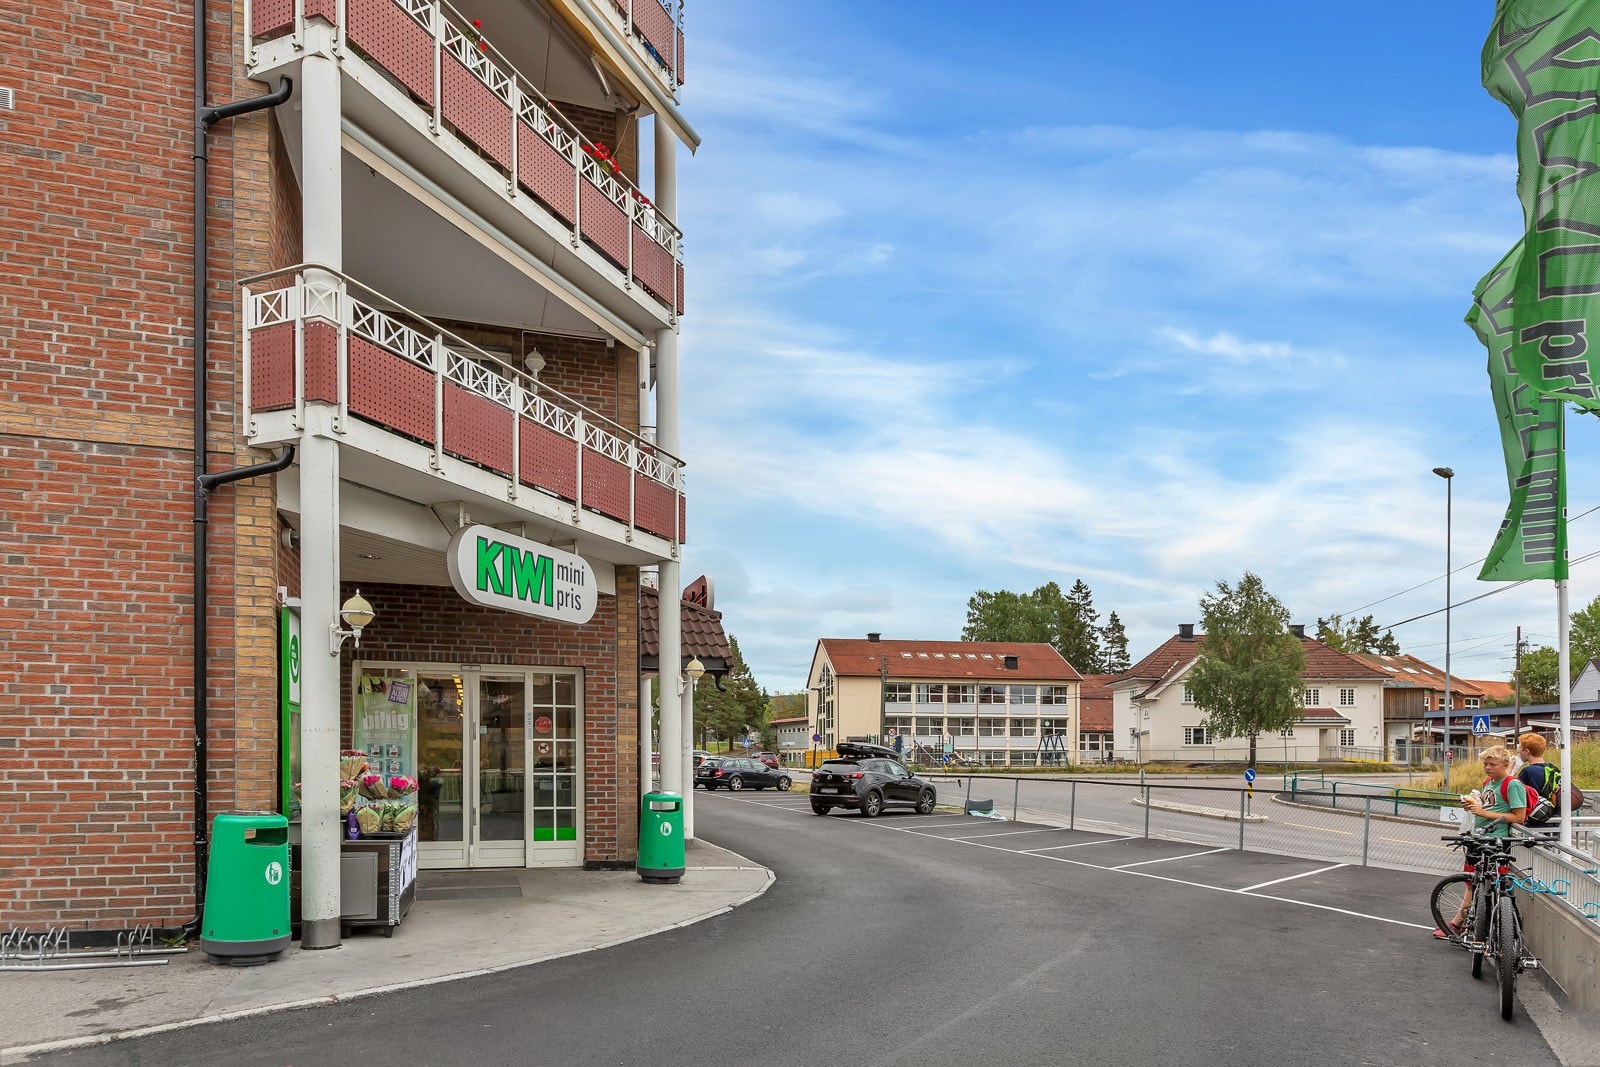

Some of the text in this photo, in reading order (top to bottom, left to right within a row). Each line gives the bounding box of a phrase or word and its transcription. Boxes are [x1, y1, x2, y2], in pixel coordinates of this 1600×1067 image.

[476, 535, 554, 608] KIWI
[556, 561, 585, 587] mini
[556, 587, 582, 611] pris
